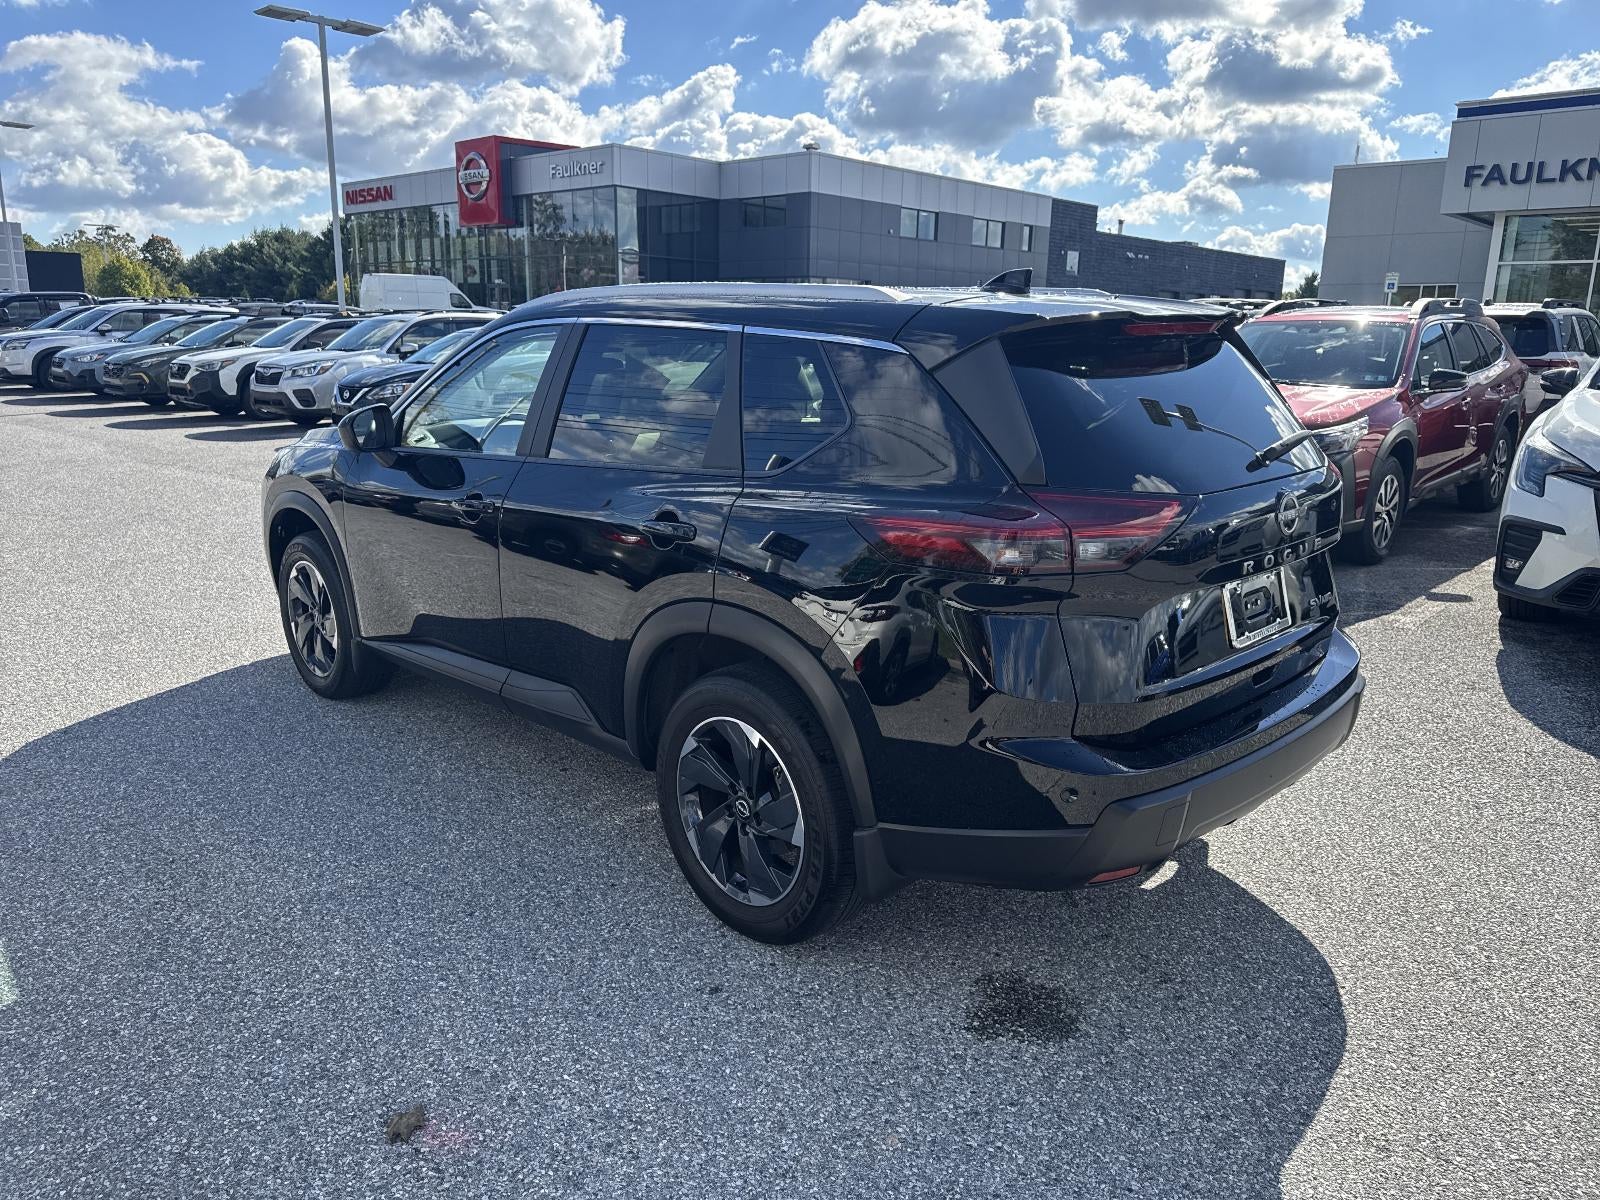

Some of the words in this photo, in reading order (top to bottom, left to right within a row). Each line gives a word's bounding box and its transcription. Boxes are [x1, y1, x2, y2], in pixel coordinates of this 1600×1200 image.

[549, 160, 602, 179] Faulkner
[345, 185, 393, 205] NISSAN
[1243, 537, 1321, 574] ROGUE
